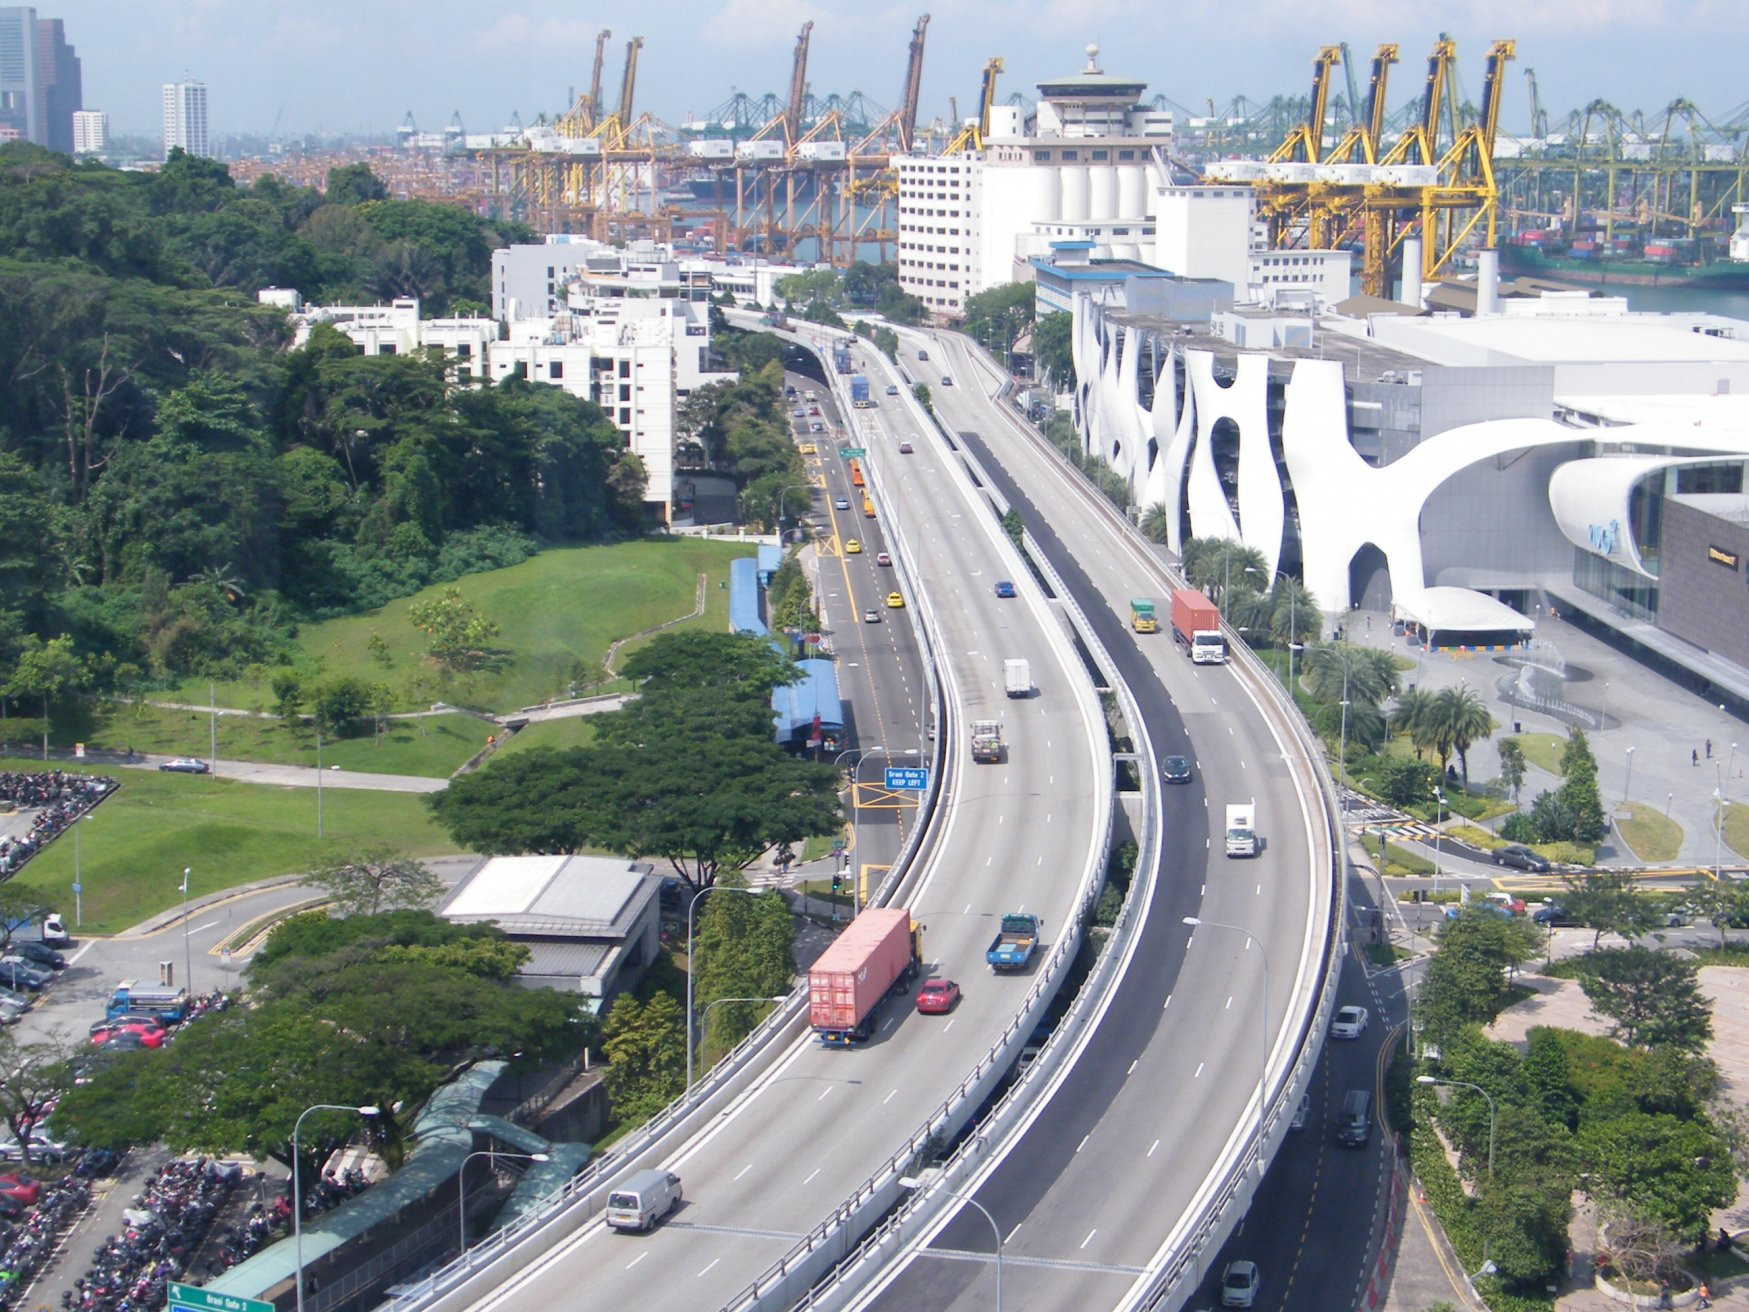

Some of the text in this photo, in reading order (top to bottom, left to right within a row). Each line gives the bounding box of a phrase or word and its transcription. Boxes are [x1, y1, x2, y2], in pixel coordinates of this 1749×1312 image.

[904, 770, 918, 778] Gate
[206, 1294, 223, 1306] Brani
[225, 1298, 240, 1309] Gate
